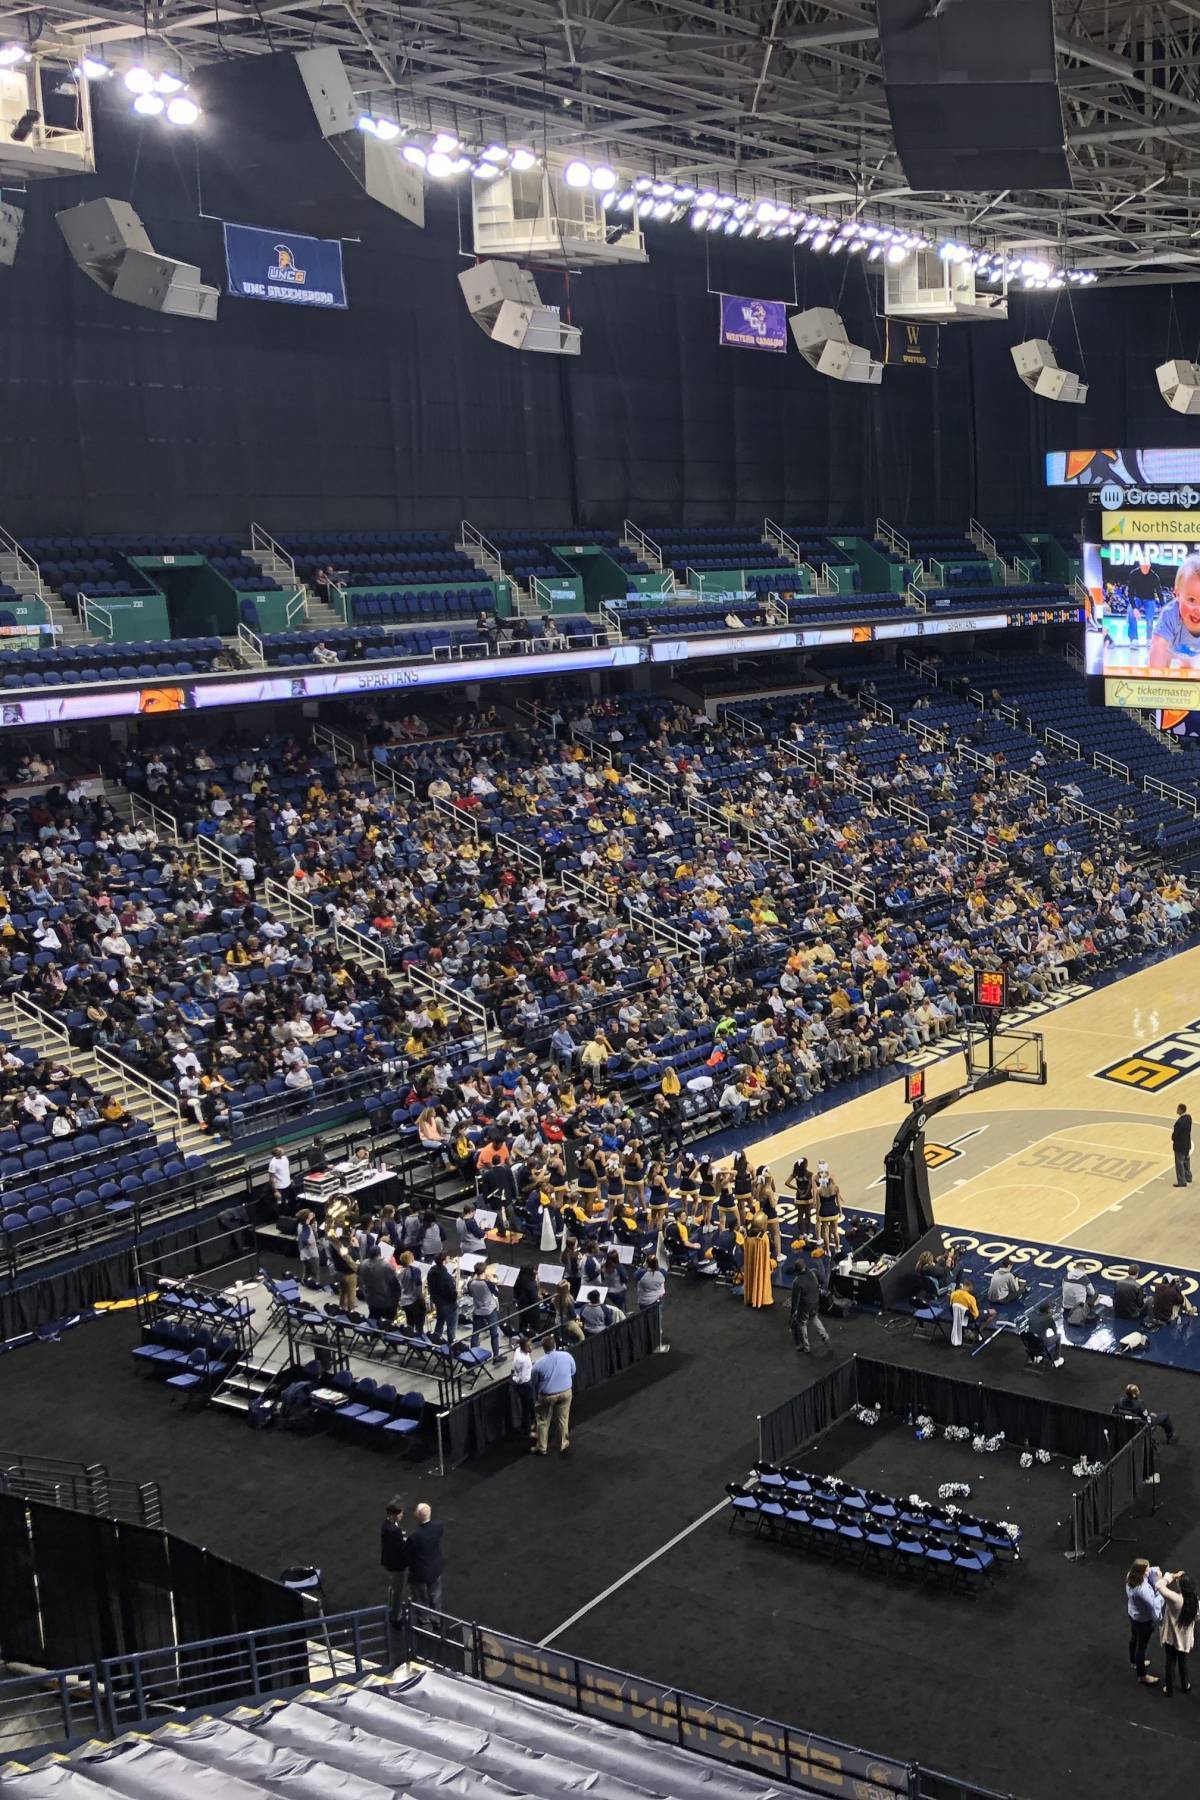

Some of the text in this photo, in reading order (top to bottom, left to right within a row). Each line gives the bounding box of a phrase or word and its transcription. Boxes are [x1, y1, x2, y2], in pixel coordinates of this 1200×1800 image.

[268, 266, 306, 284] UNCG
[243, 281, 265, 296] UNC
[1109, 543, 1188, 566] DIAPER
[358, 670, 419, 689] SPARTANS
[983, 973, 1003, 985] 3:59
[1017, 1145, 1161, 1182] SOCON
